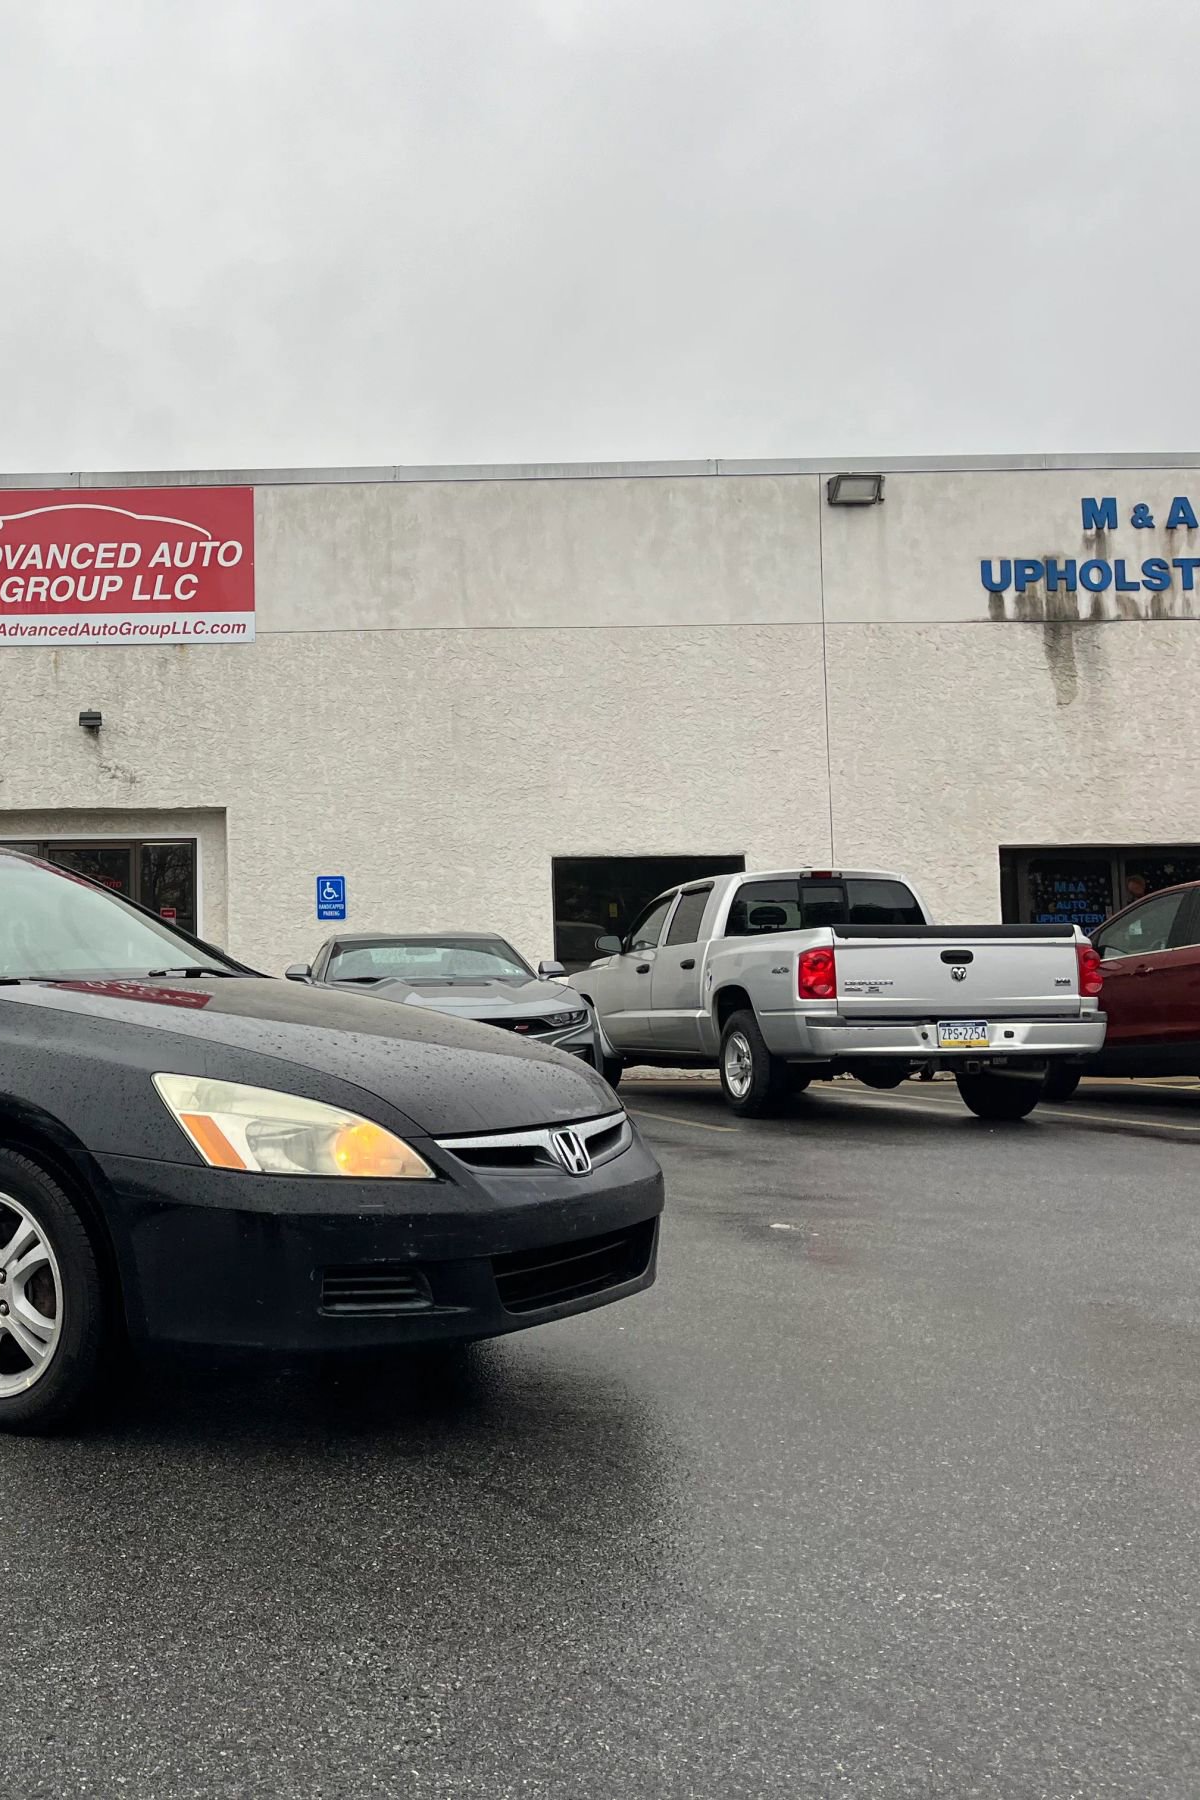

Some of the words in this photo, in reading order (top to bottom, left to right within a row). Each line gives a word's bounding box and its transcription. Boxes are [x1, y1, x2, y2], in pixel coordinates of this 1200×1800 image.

[1081, 497, 1118, 530] M
[1130, 503, 1155, 529] &
[1166, 496, 1199, 530] A
[148, 540, 244, 568] AUTO
[0, 575, 123, 603] GROUP
[131, 573, 199, 600] LLC
[980, 558, 1200, 592] UPHOLST
[1036, 913, 1105, 923] UPHOLSTERY
[1056, 900, 1088, 910] AUTO
